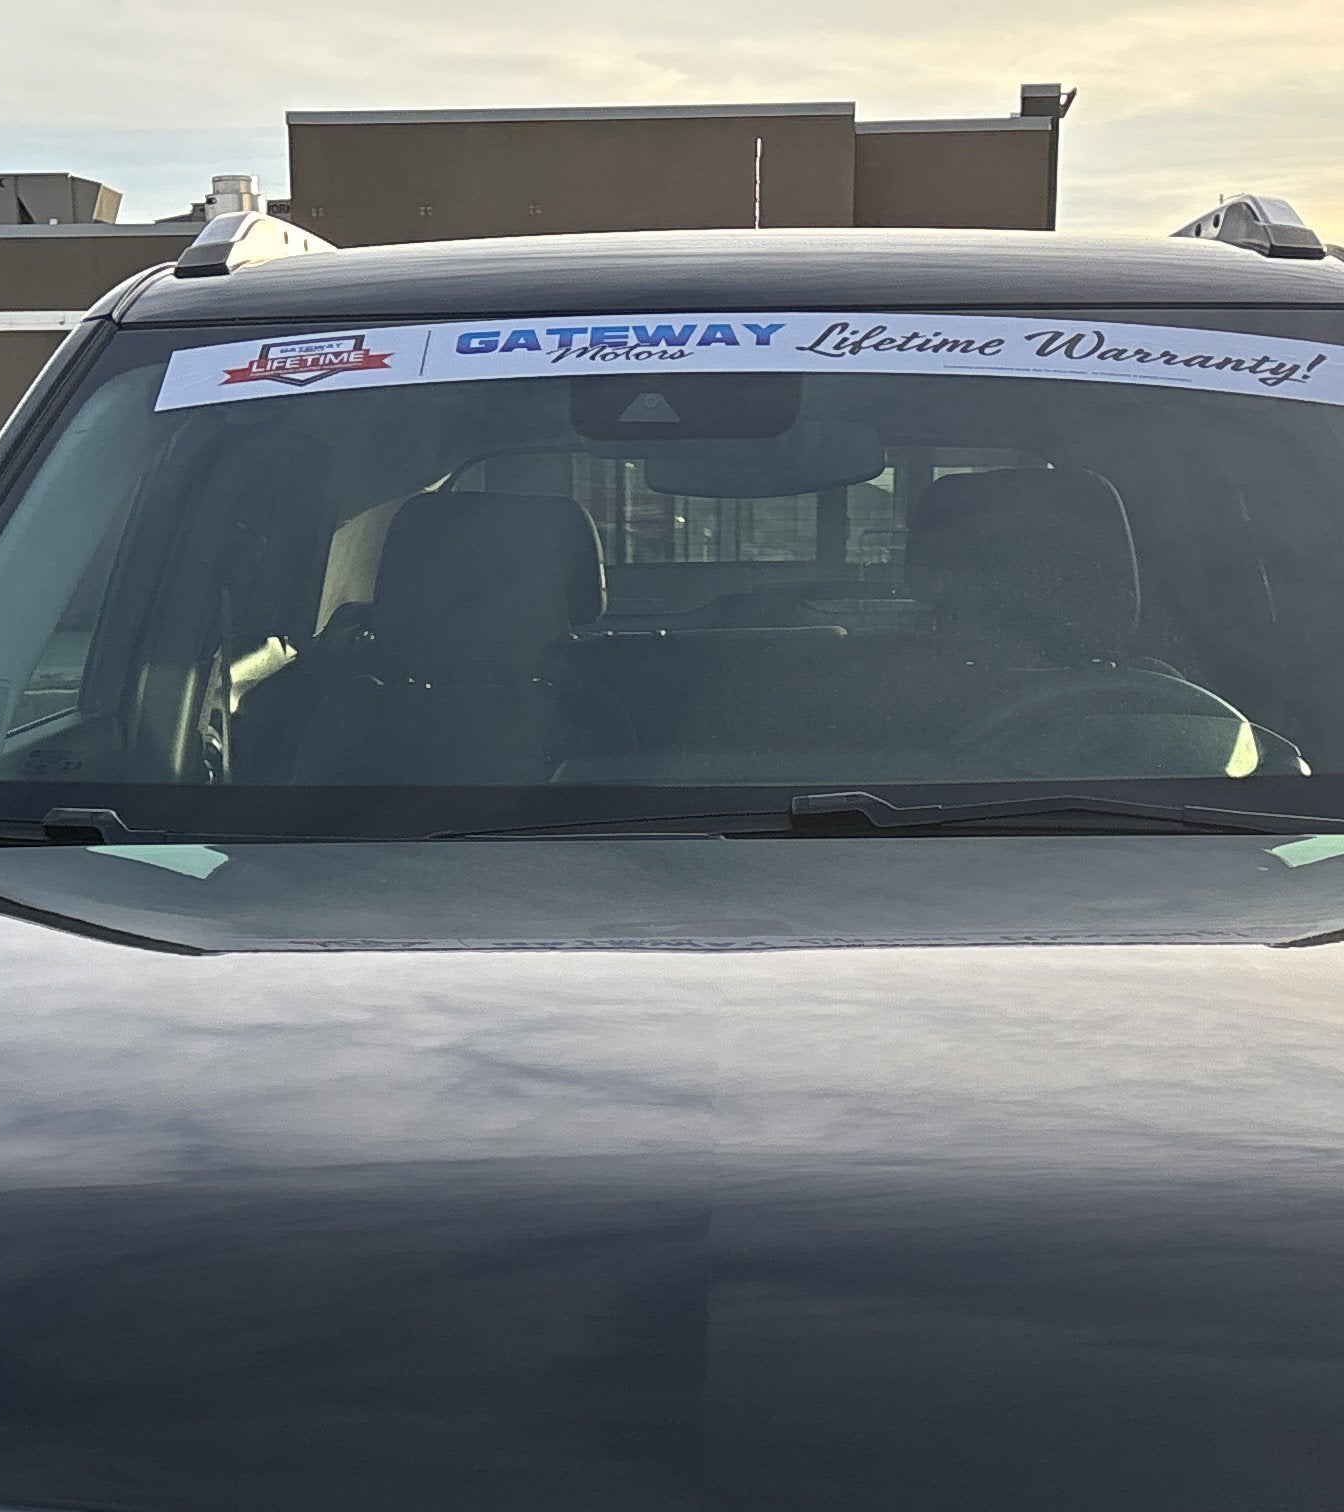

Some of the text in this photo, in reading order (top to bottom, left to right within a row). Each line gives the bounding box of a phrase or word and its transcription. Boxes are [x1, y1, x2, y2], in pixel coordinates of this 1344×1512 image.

[456, 323, 787, 354] GATEWAY
[251, 350, 365, 373] LIFETIME
[545, 343, 694, 364] Motors
[795, 322, 1006, 358] Lifetime
[1024, 330, 1327, 387] Warranty!
